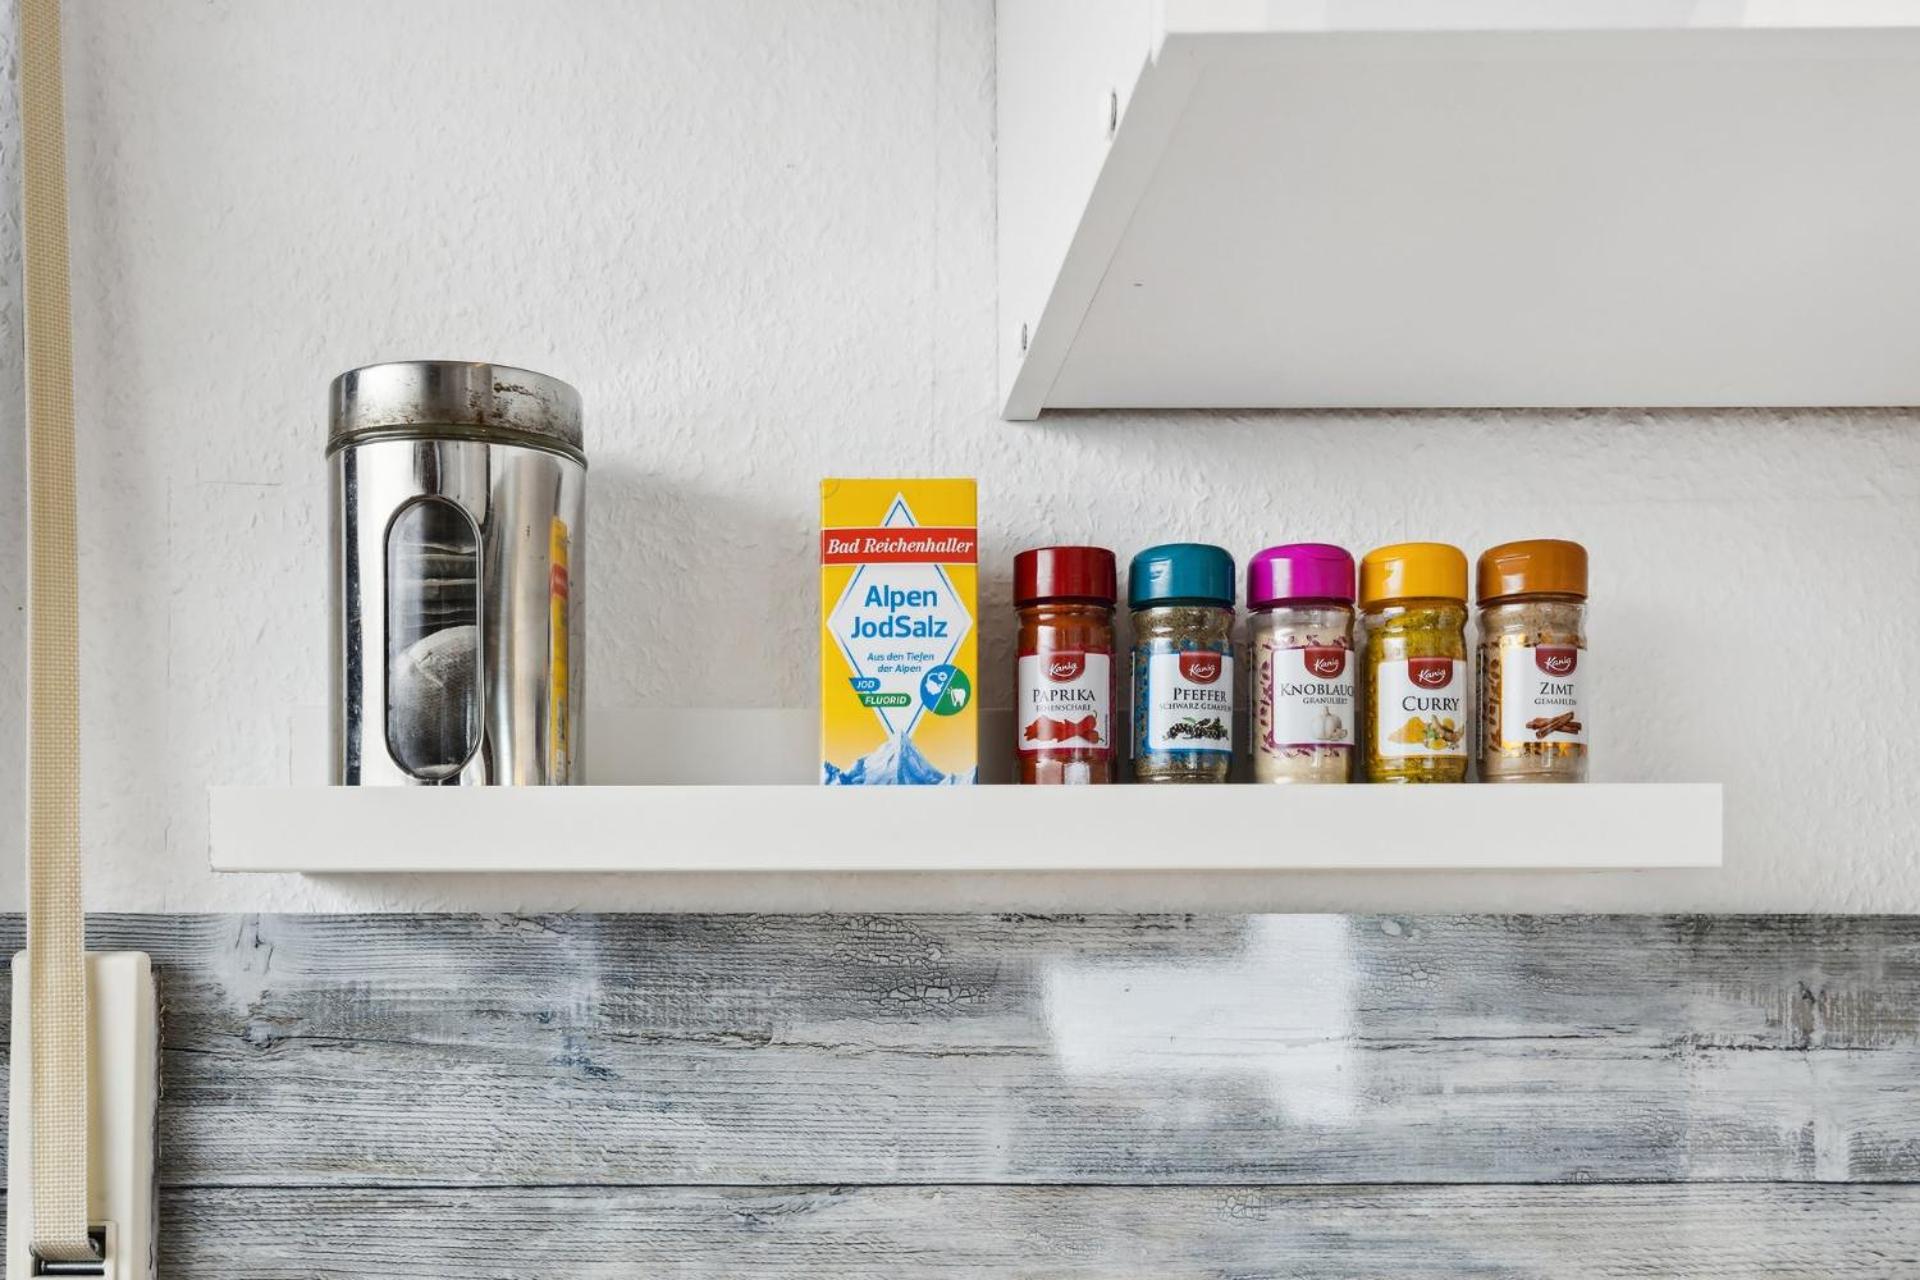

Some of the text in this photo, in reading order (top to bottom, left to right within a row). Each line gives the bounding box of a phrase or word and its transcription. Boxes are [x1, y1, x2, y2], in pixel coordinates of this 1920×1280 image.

[827, 537, 973, 554] Bad Reichenhaller
[864, 584, 938, 613] Alpen
[851, 615, 948, 638] JodSalz
[867, 652, 934, 662] Aus den Tiefen
[877, 664, 922, 674] der Alpen
[857, 680, 875, 689] JOD
[1540, 682, 1574, 696] ZIMT
[865, 695, 907, 705] FLUORID
[1033, 688, 1096, 703] PAPRIKA
[1173, 687, 1227, 702] PFEFFER
[1402, 696, 1459, 711] CURRY
